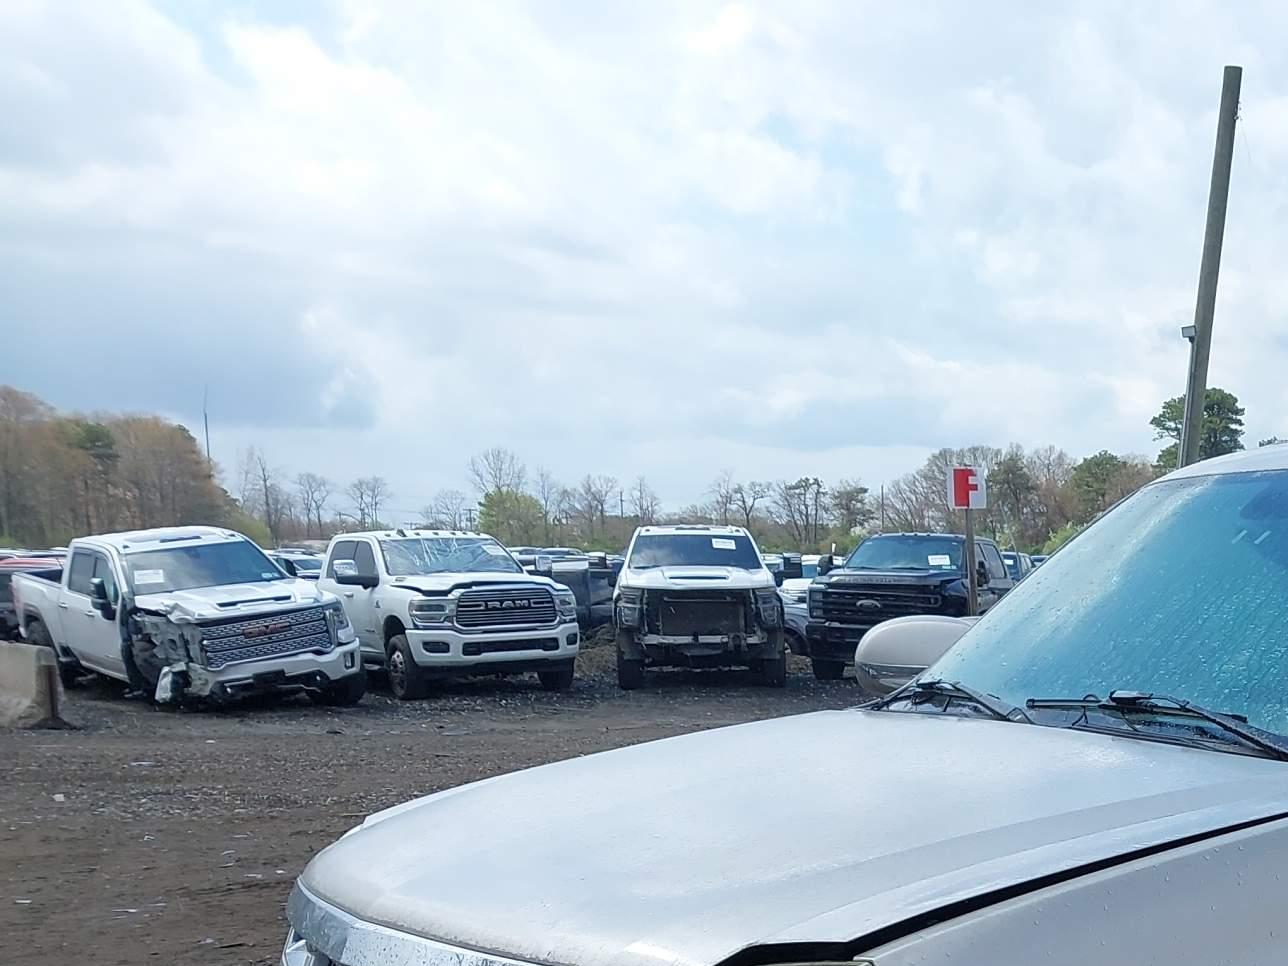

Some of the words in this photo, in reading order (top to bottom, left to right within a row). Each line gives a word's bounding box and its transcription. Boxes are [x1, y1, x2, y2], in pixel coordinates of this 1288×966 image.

[953, 468, 978, 507] F
[487, 599, 529, 609] RAM
[242, 621, 292, 639] GMC
